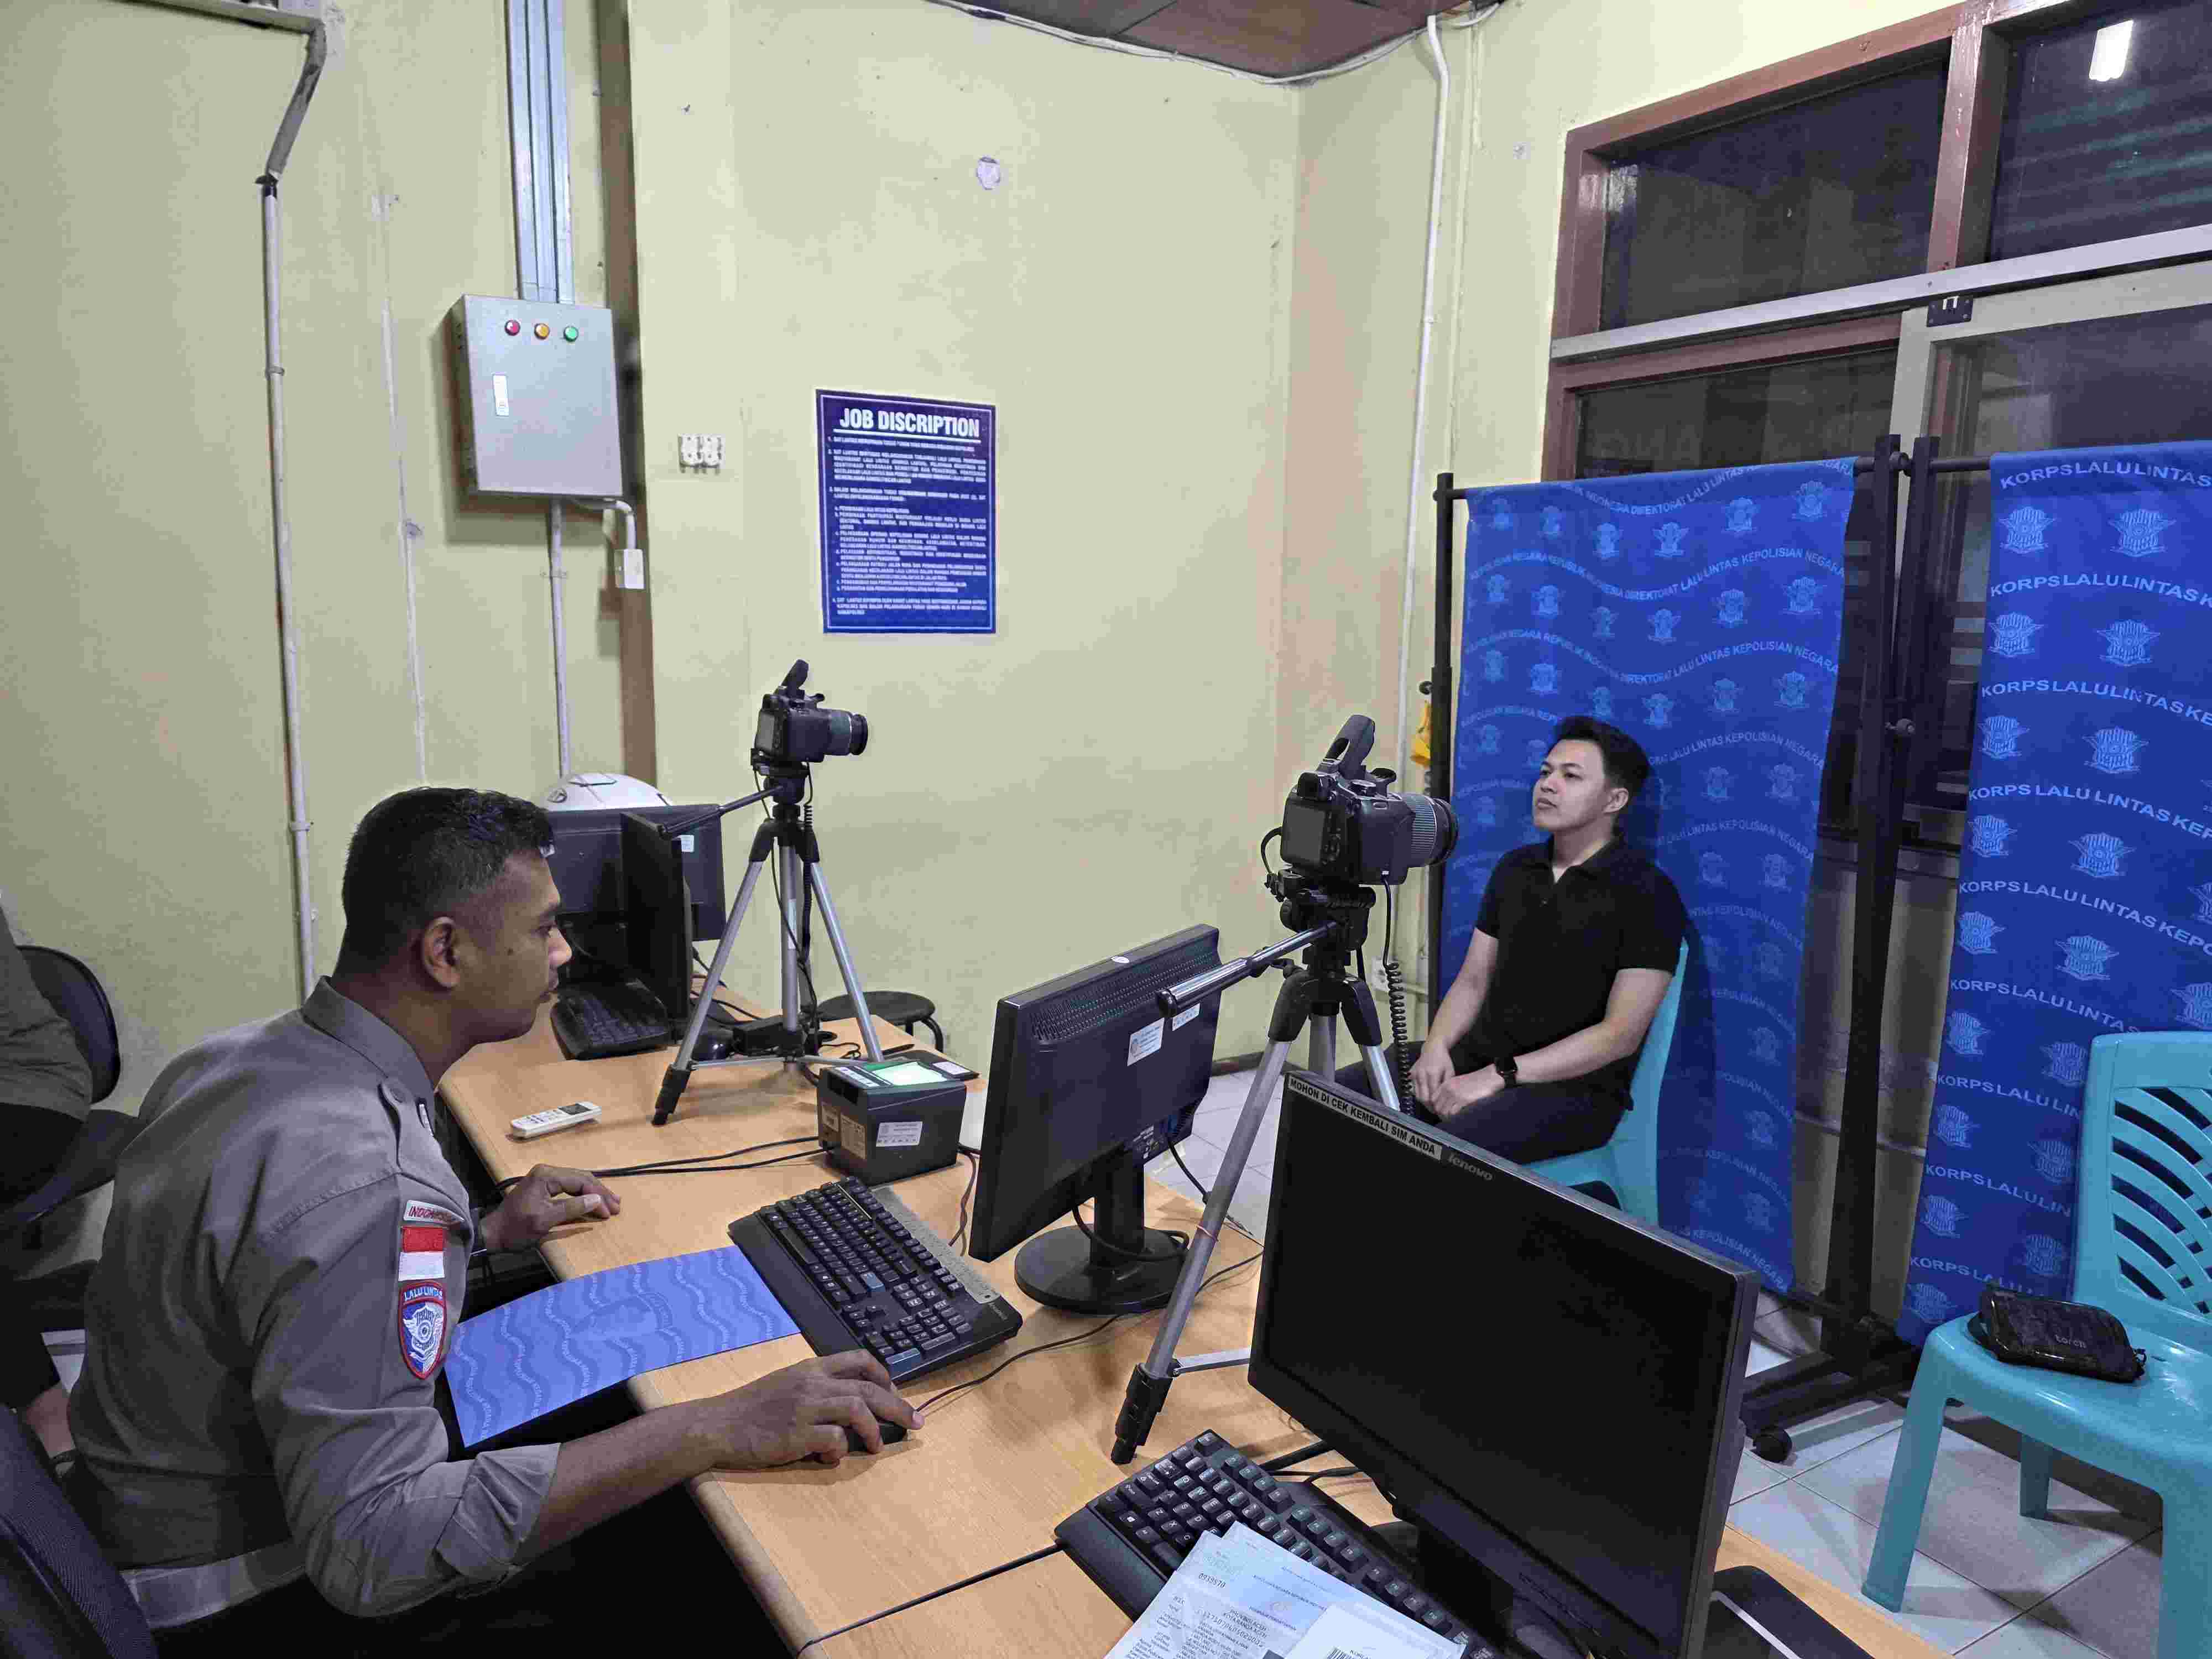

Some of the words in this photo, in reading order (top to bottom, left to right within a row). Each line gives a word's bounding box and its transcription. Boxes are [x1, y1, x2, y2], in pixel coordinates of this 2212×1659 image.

[839, 408, 874, 429] JOB
[878, 410, 980, 437] DISCRIPTION
[1687, 483, 1710, 502] LALU
[2000, 463, 2073, 489] KORPS
[2075, 461, 2131, 474] LALU
[2133, 462, 2212, 487] LINTAS
[1703, 556, 1740, 577] LINTAS
[1741, 546, 1803, 566] KEPOLISIAN
[1804, 550, 1845, 577] NEGARA
[1991, 575, 2061, 597] KORPS
[2063, 572, 2119, 587] LALU
[2121, 575, 2199, 602] LINTAS
[1694, 646, 1731, 667] LINTAS
[1732, 640, 1794, 656] KEPOLISIAN
[1794, 644, 1839, 675] NEGARA
[1981, 680, 2049, 697] KORPS
[2052, 680, 2109, 695] LALU
[2110, 686, 2184, 714] LINTAS
[2184, 705, 2212, 726] KE
[1691, 735, 1725, 753] LINTAS
[1724, 730, 1784, 747] KEPOLISIAN
[1783, 737, 1825, 771] NEGARA
[1969, 784, 2031, 802] KORPS
[2035, 784, 2091, 800] LALU
[2094, 792, 2171, 822] LINTAS
[1959, 880, 2021, 894] KORPS
[2023, 882, 2078, 902] LALU
[2080, 894, 2157, 928] LINTAS
[1951, 979, 2011, 995] KORPS
[2012, 985, 2065, 1008] LALU
[2066, 1000, 2141, 1035] LINTAS
[1937, 1074, 1995, 1093] KORPS
[1996, 1084, 2049, 1107] LALU
[2052, 1099, 2081, 1120] LIN
[1290, 1078, 1319, 1101] MOHON
[1321, 1091, 1330, 1105] DI
[1331, 1096, 1348, 1113] CEK
[1349, 1104, 1389, 1132] KEMBALI
[1391, 1124, 1408, 1140] SIM
[1408, 1131, 1436, 1155] ANDA
[1448, 1152, 1493, 1181] lenovo
[1924, 1163, 1985, 1186] KORPS
[1986, 1176, 2038, 1203] LALU
[2038, 1193, 2073, 1218] LIN
[1910, 1255, 1971, 1276] KORPS
